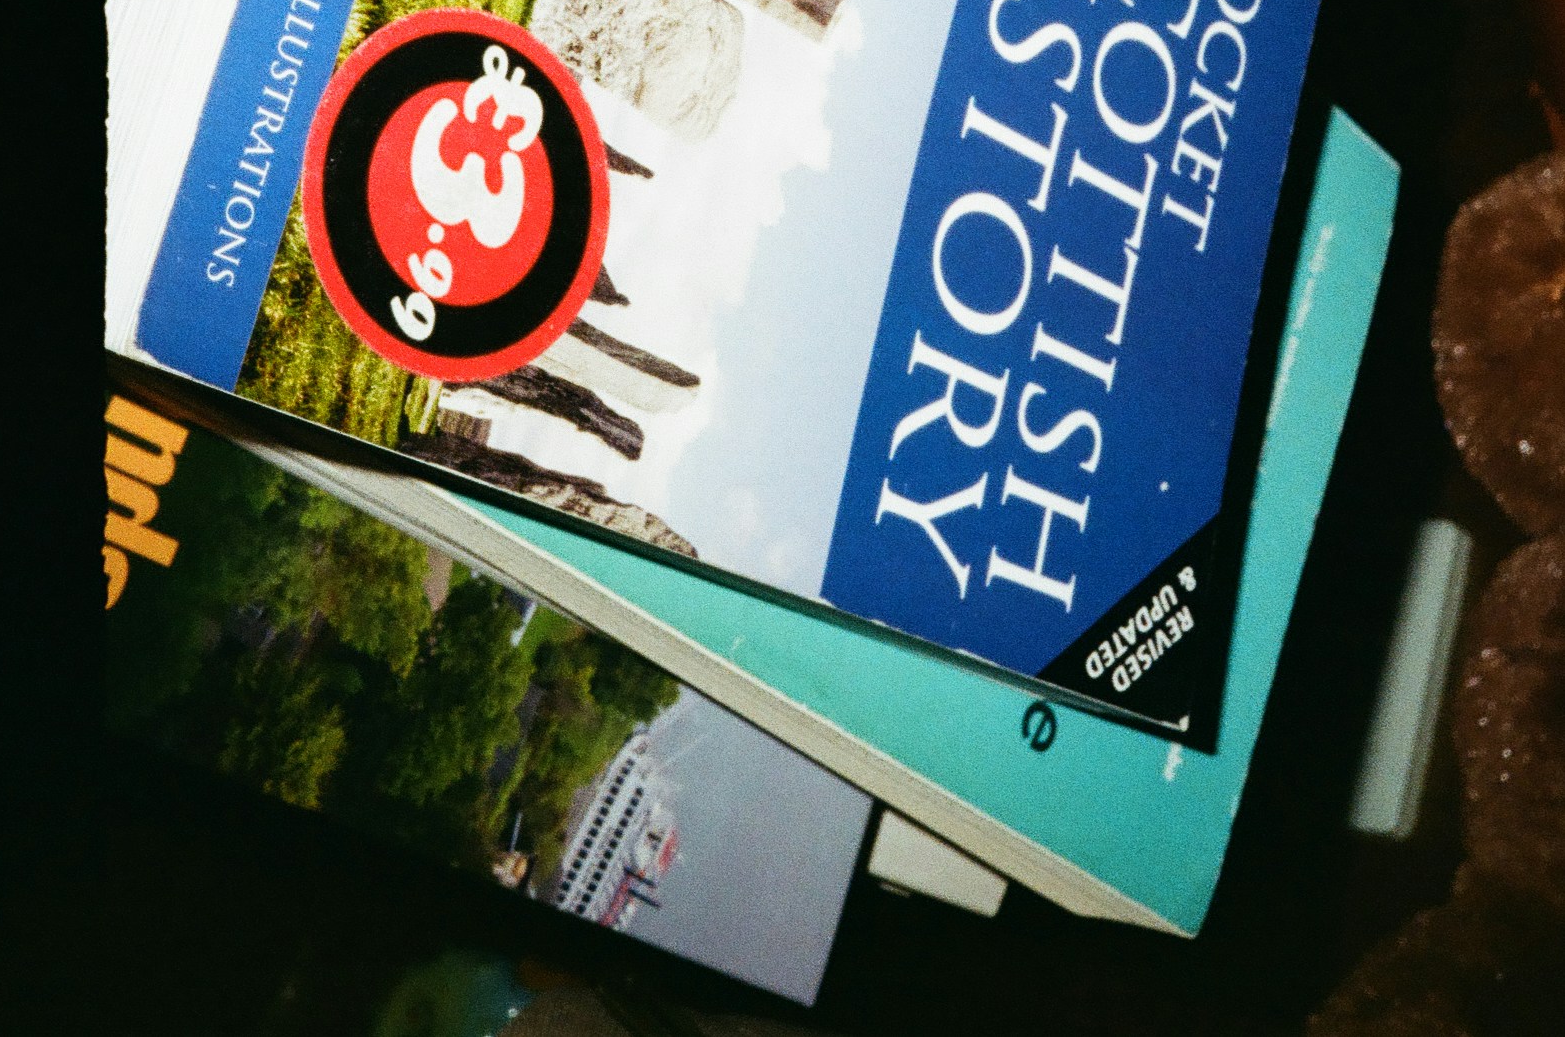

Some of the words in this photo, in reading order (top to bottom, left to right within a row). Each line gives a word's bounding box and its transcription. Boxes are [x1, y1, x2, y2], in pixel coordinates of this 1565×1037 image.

[391, 44, 544, 341] £3.99
[1179, 567, 1195, 590] &
[1086, 586, 1177, 677] UPDATED
[1113, 607, 1193, 691] REVISED
